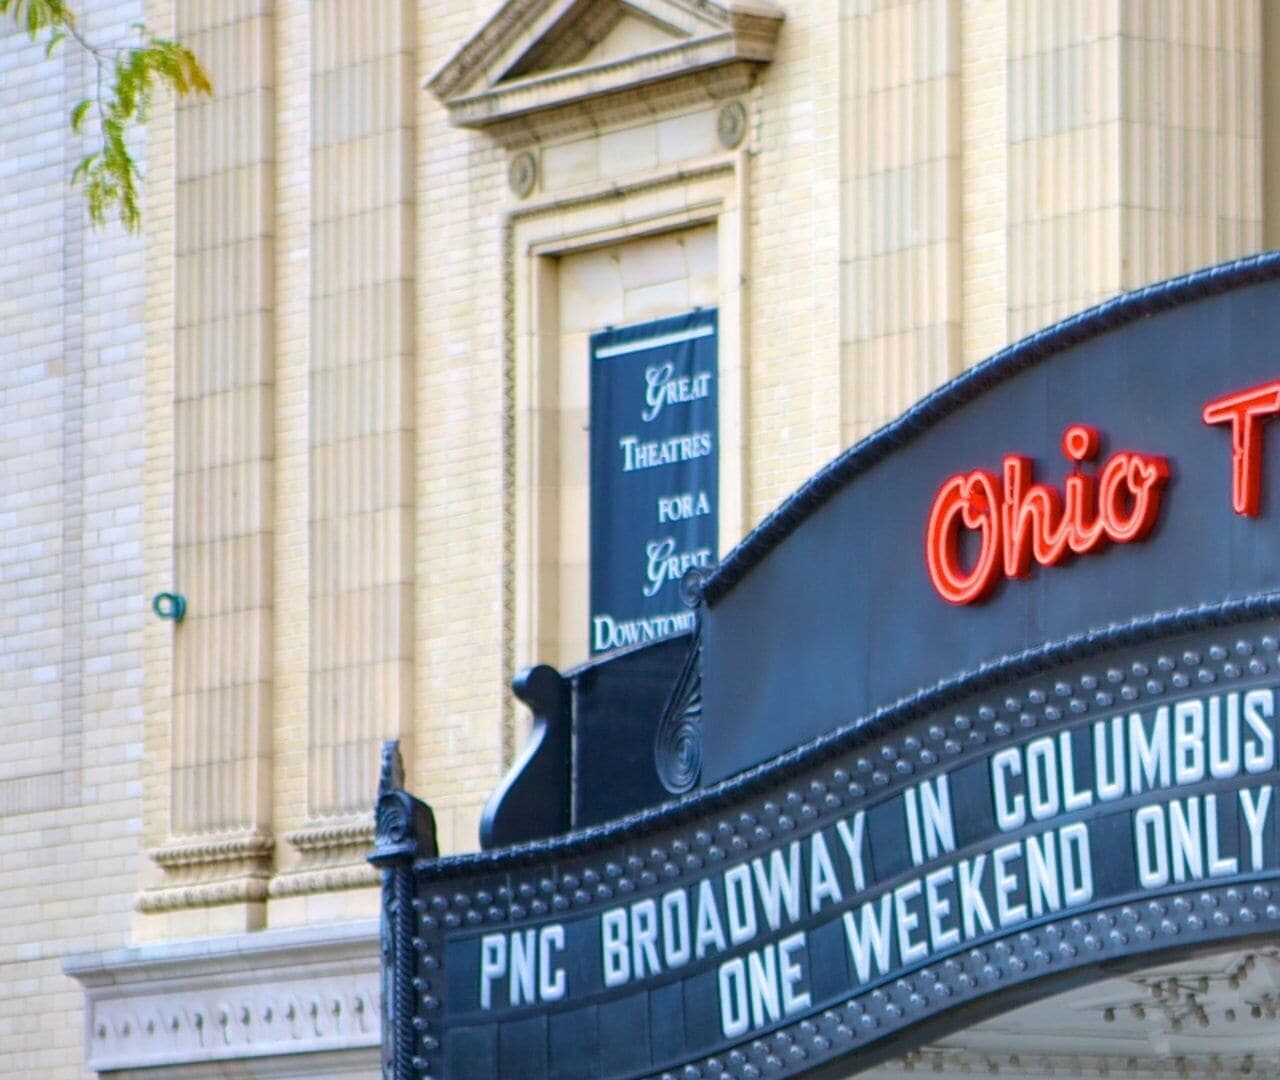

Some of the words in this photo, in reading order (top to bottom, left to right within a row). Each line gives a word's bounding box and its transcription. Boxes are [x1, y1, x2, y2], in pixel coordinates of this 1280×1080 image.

[657, 497, 692, 524] FOR
[695, 491, 710, 515] A
[924, 424, 1170, 606] Ohio
[480, 924, 567, 1011] PNC
[600, 810, 870, 985] BROADWAY
[903, 772, 957, 868] IN
[991, 688, 1277, 829] COLUMBUS
[717, 933, 812, 1039] ONE
[842, 821, 1094, 985] WEEKEND
[1133, 787, 1273, 890] ONLY
